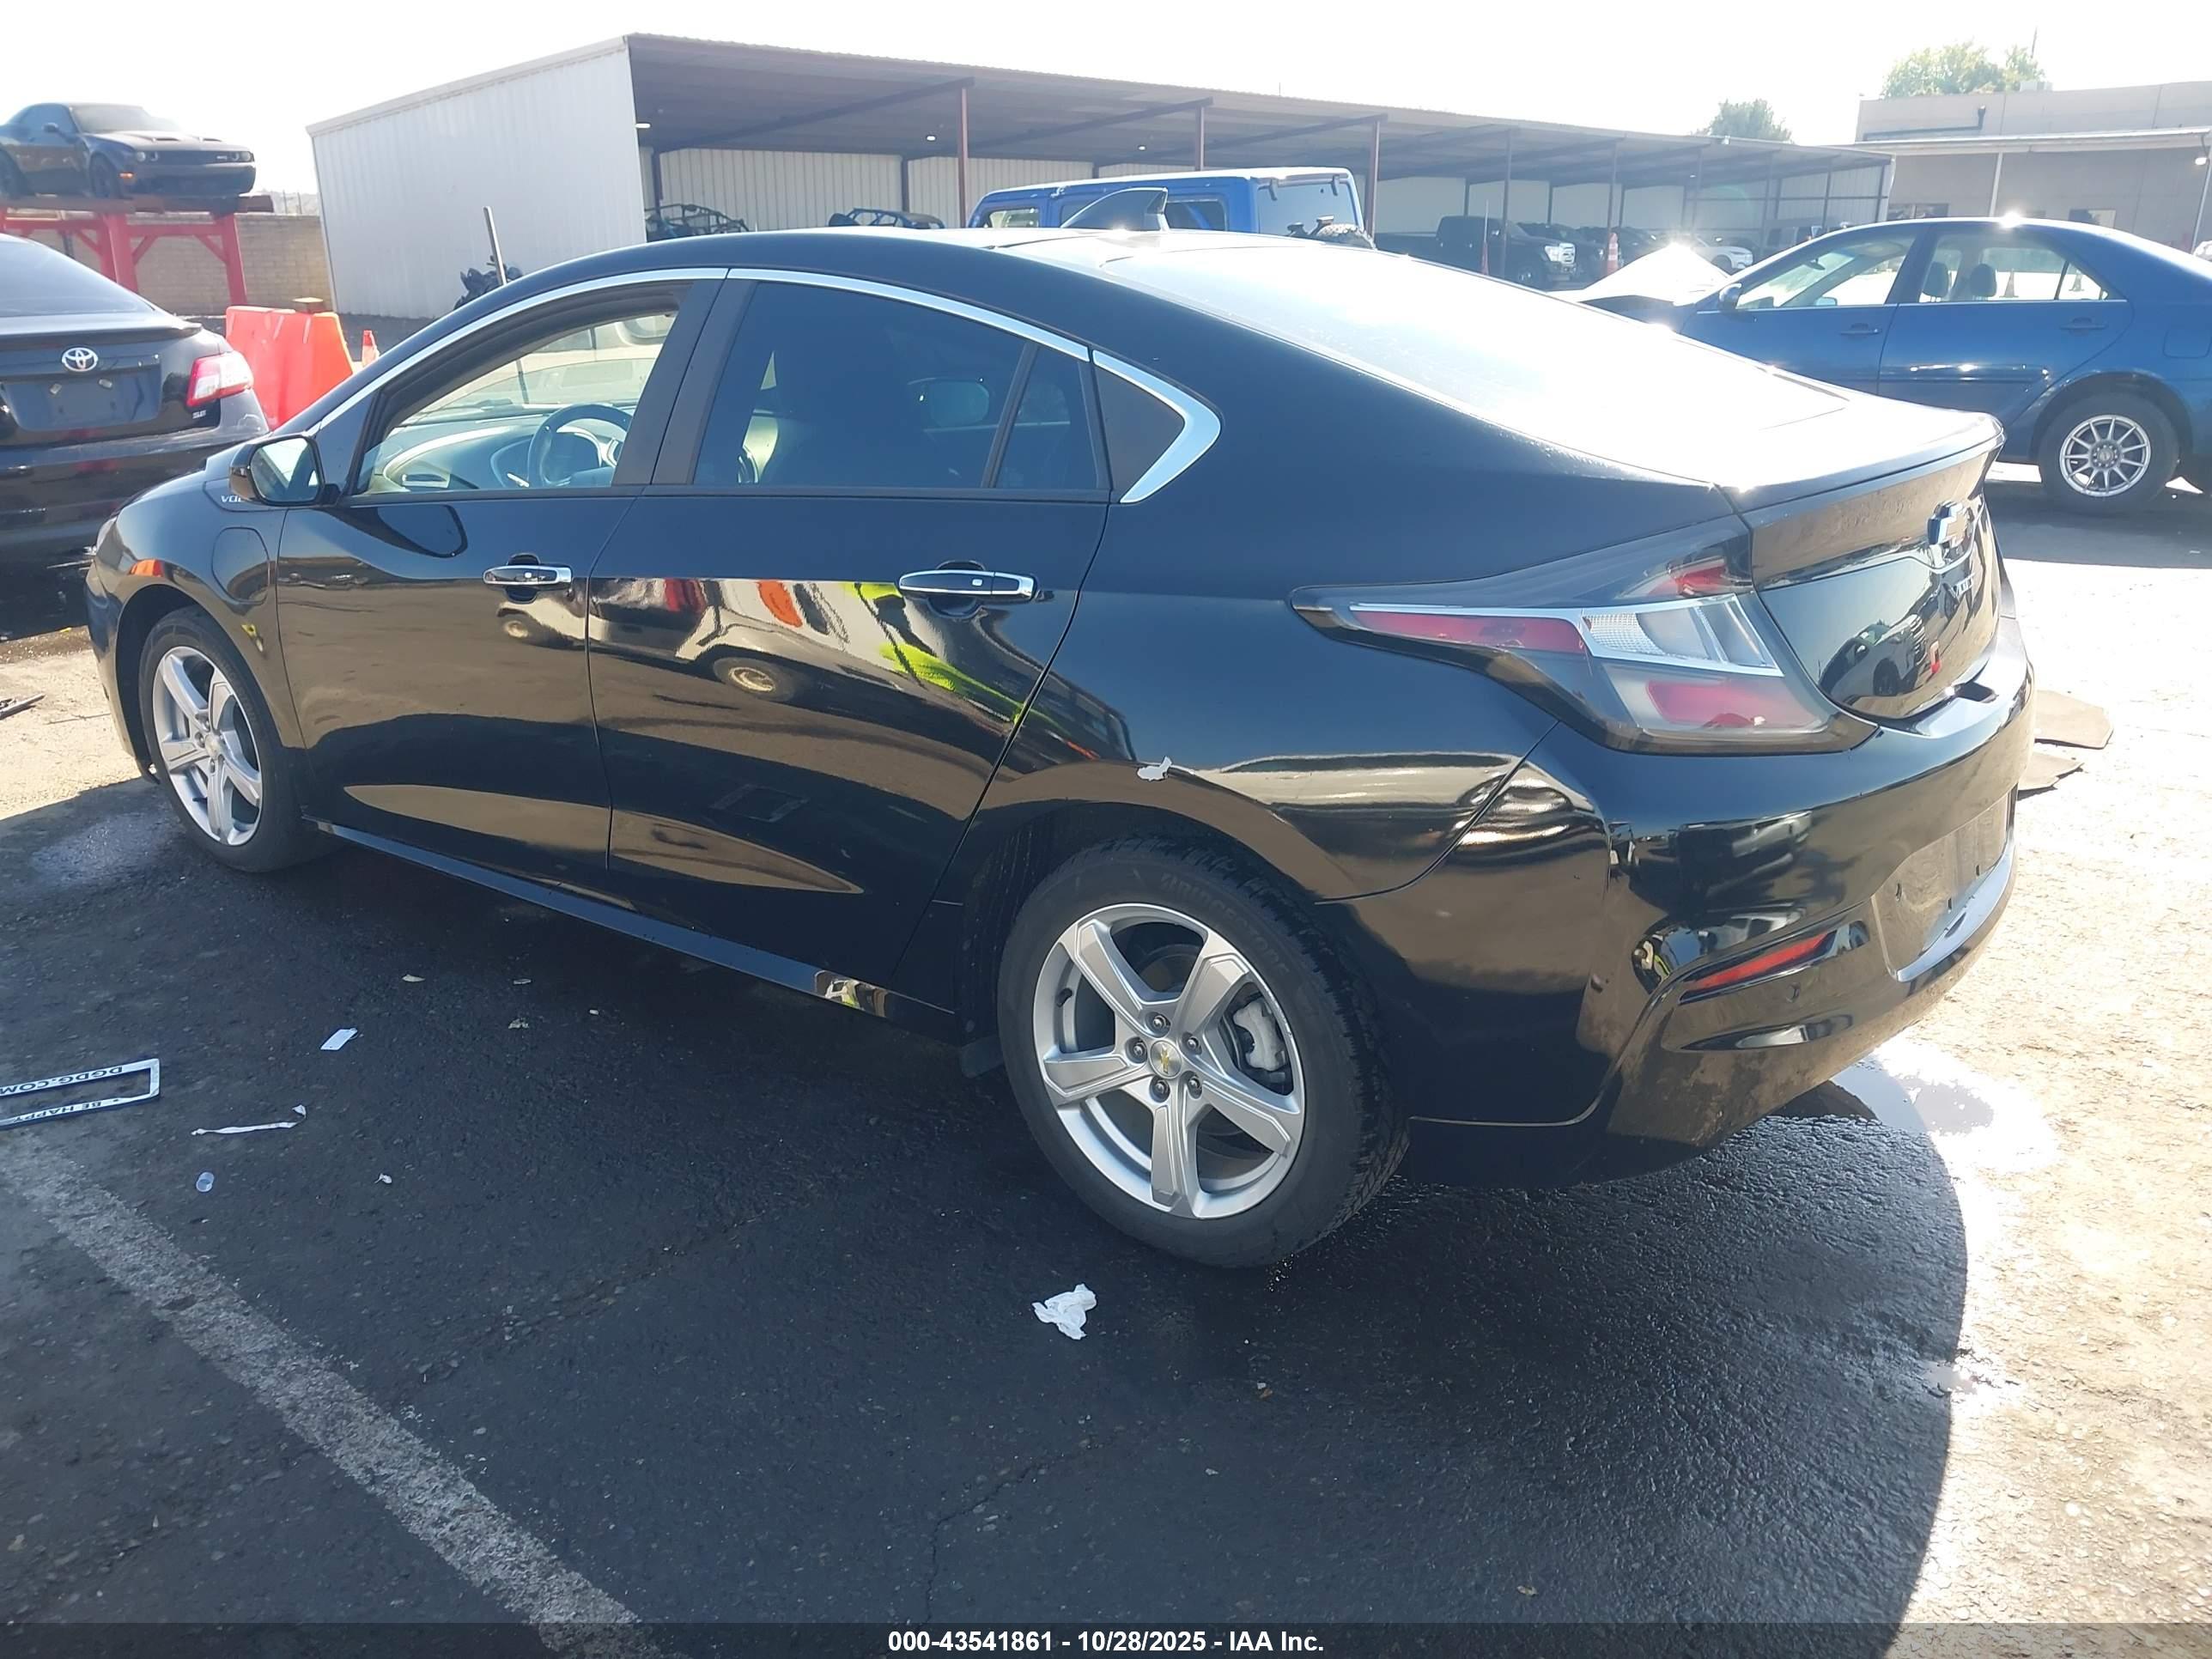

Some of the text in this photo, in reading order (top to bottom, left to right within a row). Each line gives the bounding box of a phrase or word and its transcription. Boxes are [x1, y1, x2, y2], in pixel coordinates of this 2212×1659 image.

[0, 1066, 123, 1095] DGDG.COM
[13, 1101, 101, 1123] BE HAPPY
